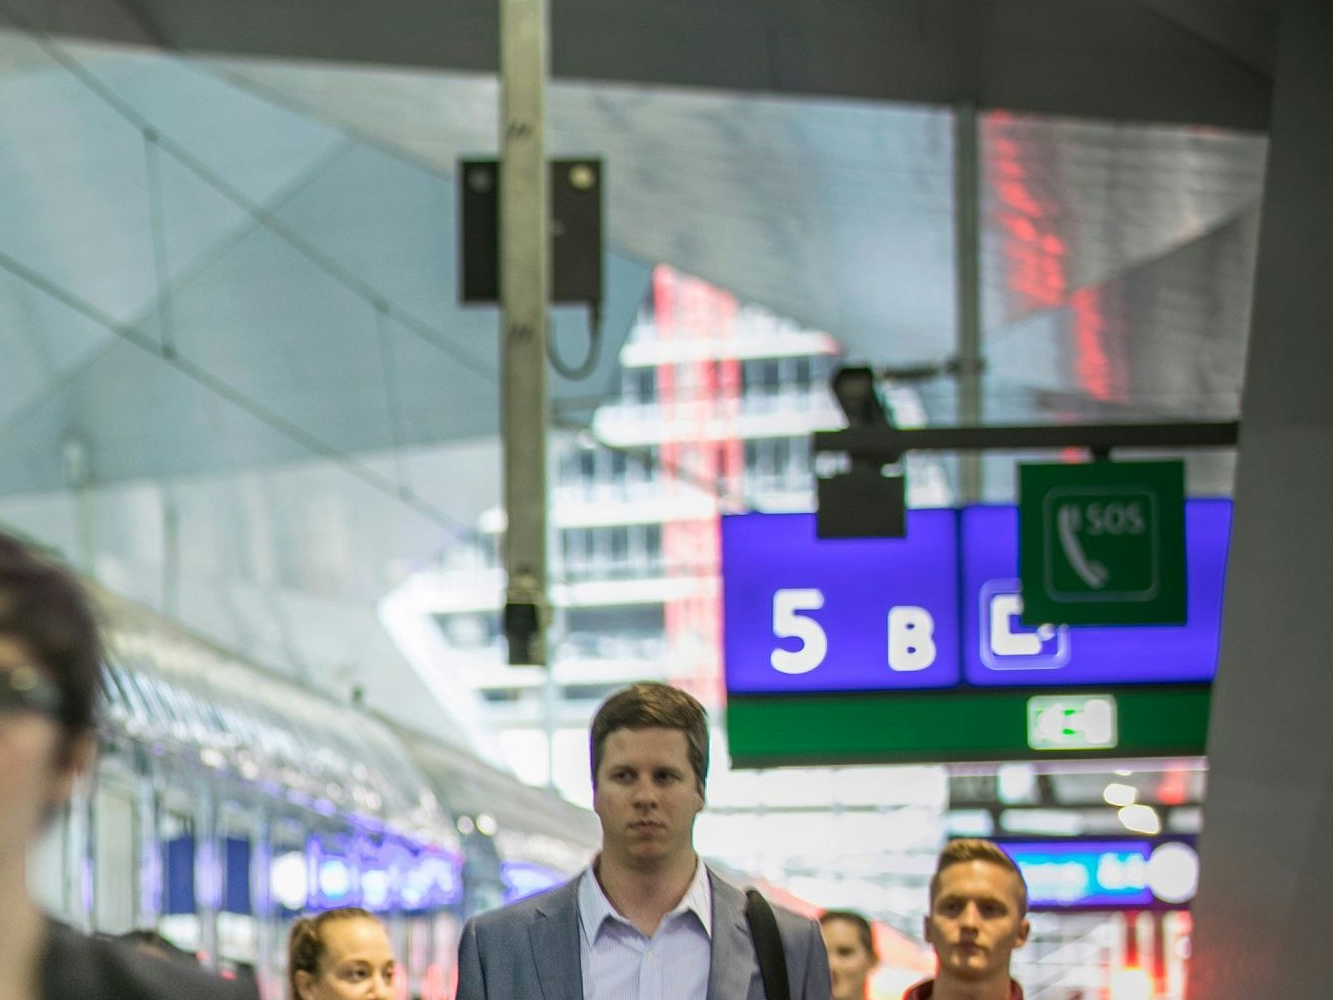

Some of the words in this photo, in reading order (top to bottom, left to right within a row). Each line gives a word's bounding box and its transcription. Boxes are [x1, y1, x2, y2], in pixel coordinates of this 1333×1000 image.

[1085, 501, 1145, 536] SOS
[770, 588, 829, 675] 5
[887, 605, 936, 672] B
